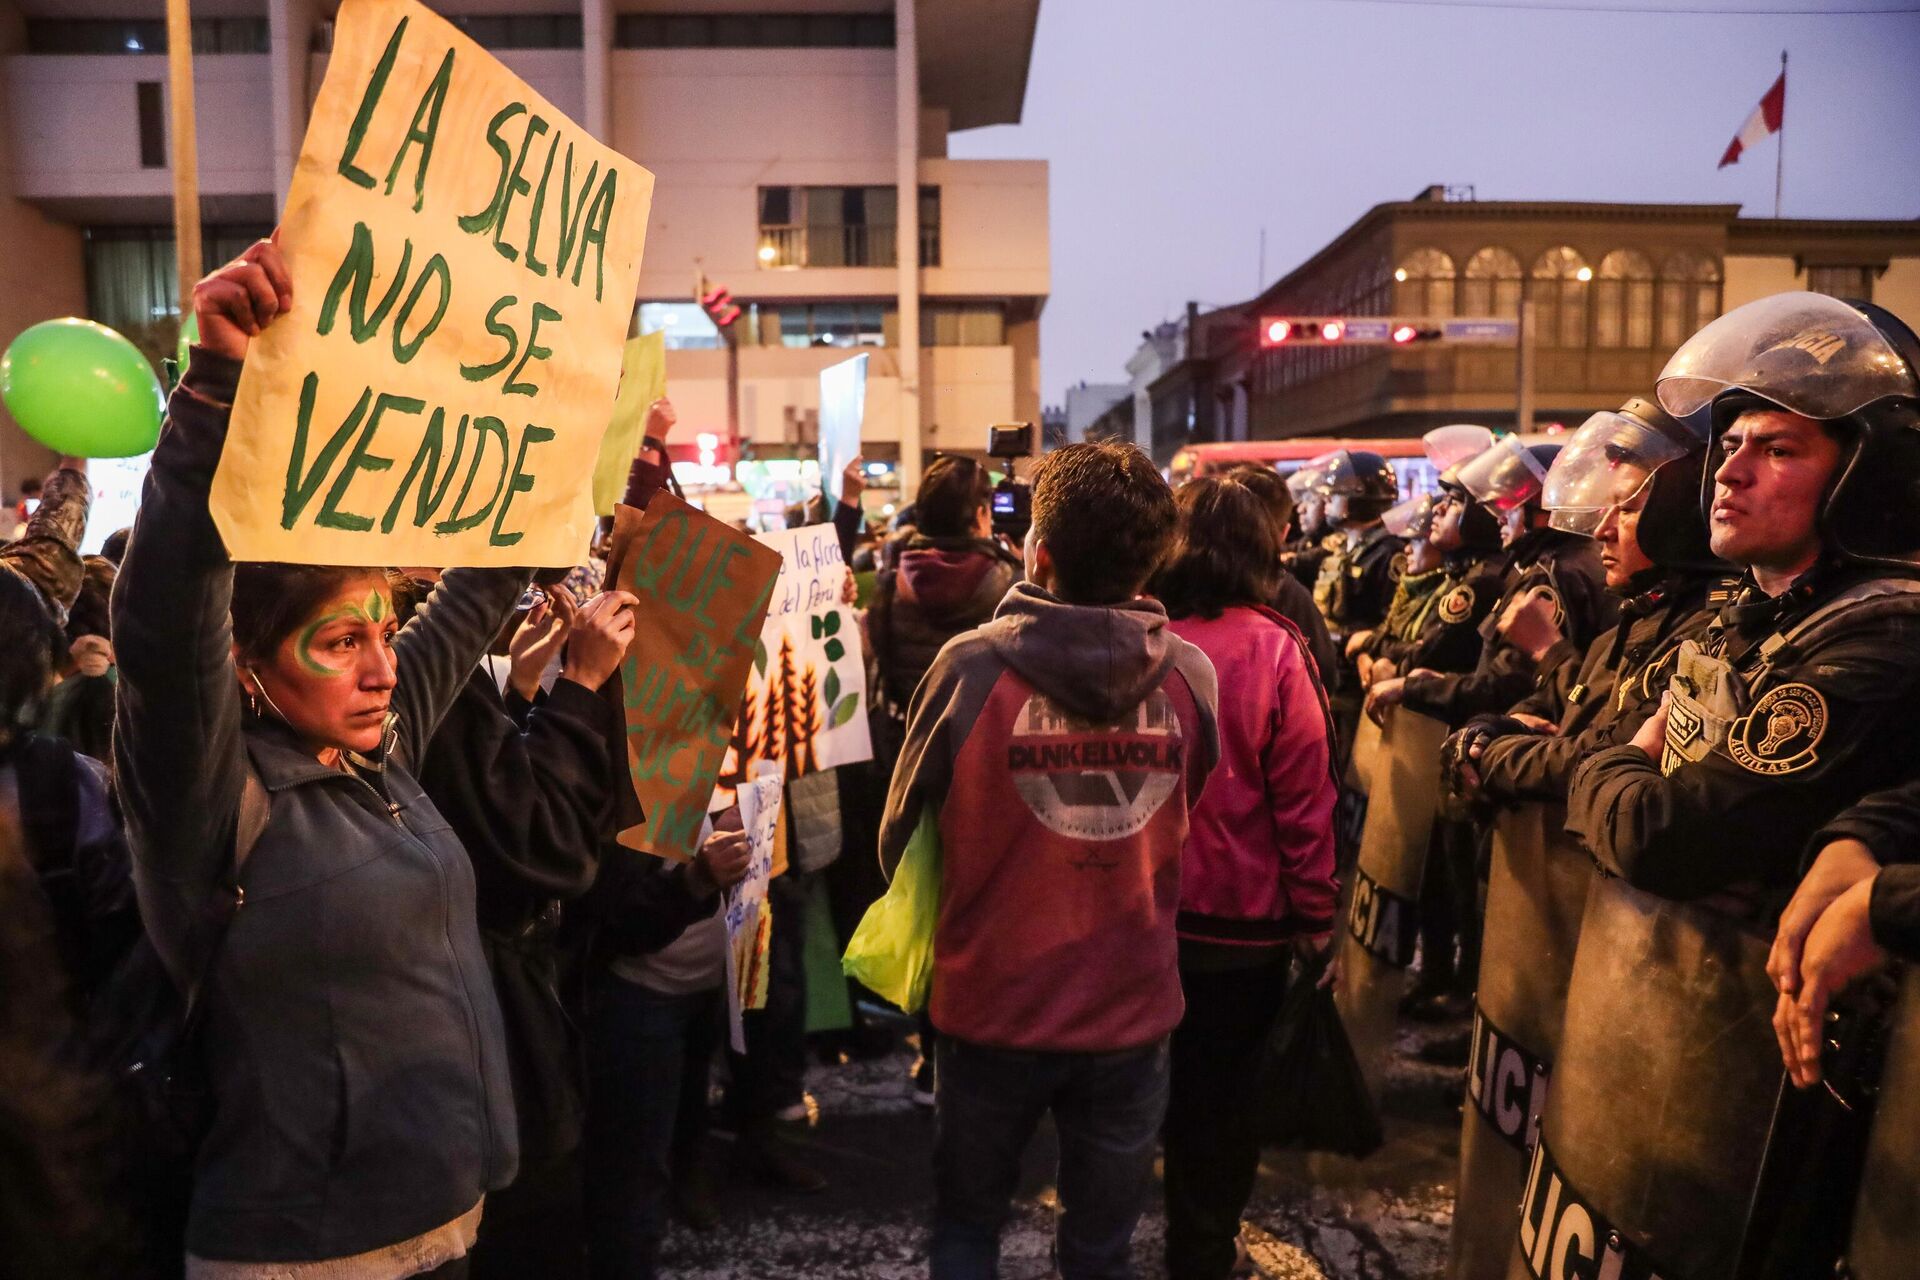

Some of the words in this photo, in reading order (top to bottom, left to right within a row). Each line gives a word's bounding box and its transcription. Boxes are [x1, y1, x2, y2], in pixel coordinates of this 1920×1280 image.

[338, 16, 455, 213] LA
[458, 102, 617, 303] SELVA
[316, 221, 451, 364] NO
[459, 295, 562, 397] SE
[281, 371, 556, 547] VENDE
[635, 509, 752, 629] QUE
[794, 534, 811, 570] la
[779, 582, 801, 615] del
[674, 631, 737, 681] DE
[1007, 741, 1184, 770] DUNKELVOLK
[1731, 738, 1790, 772] AGUILAS
